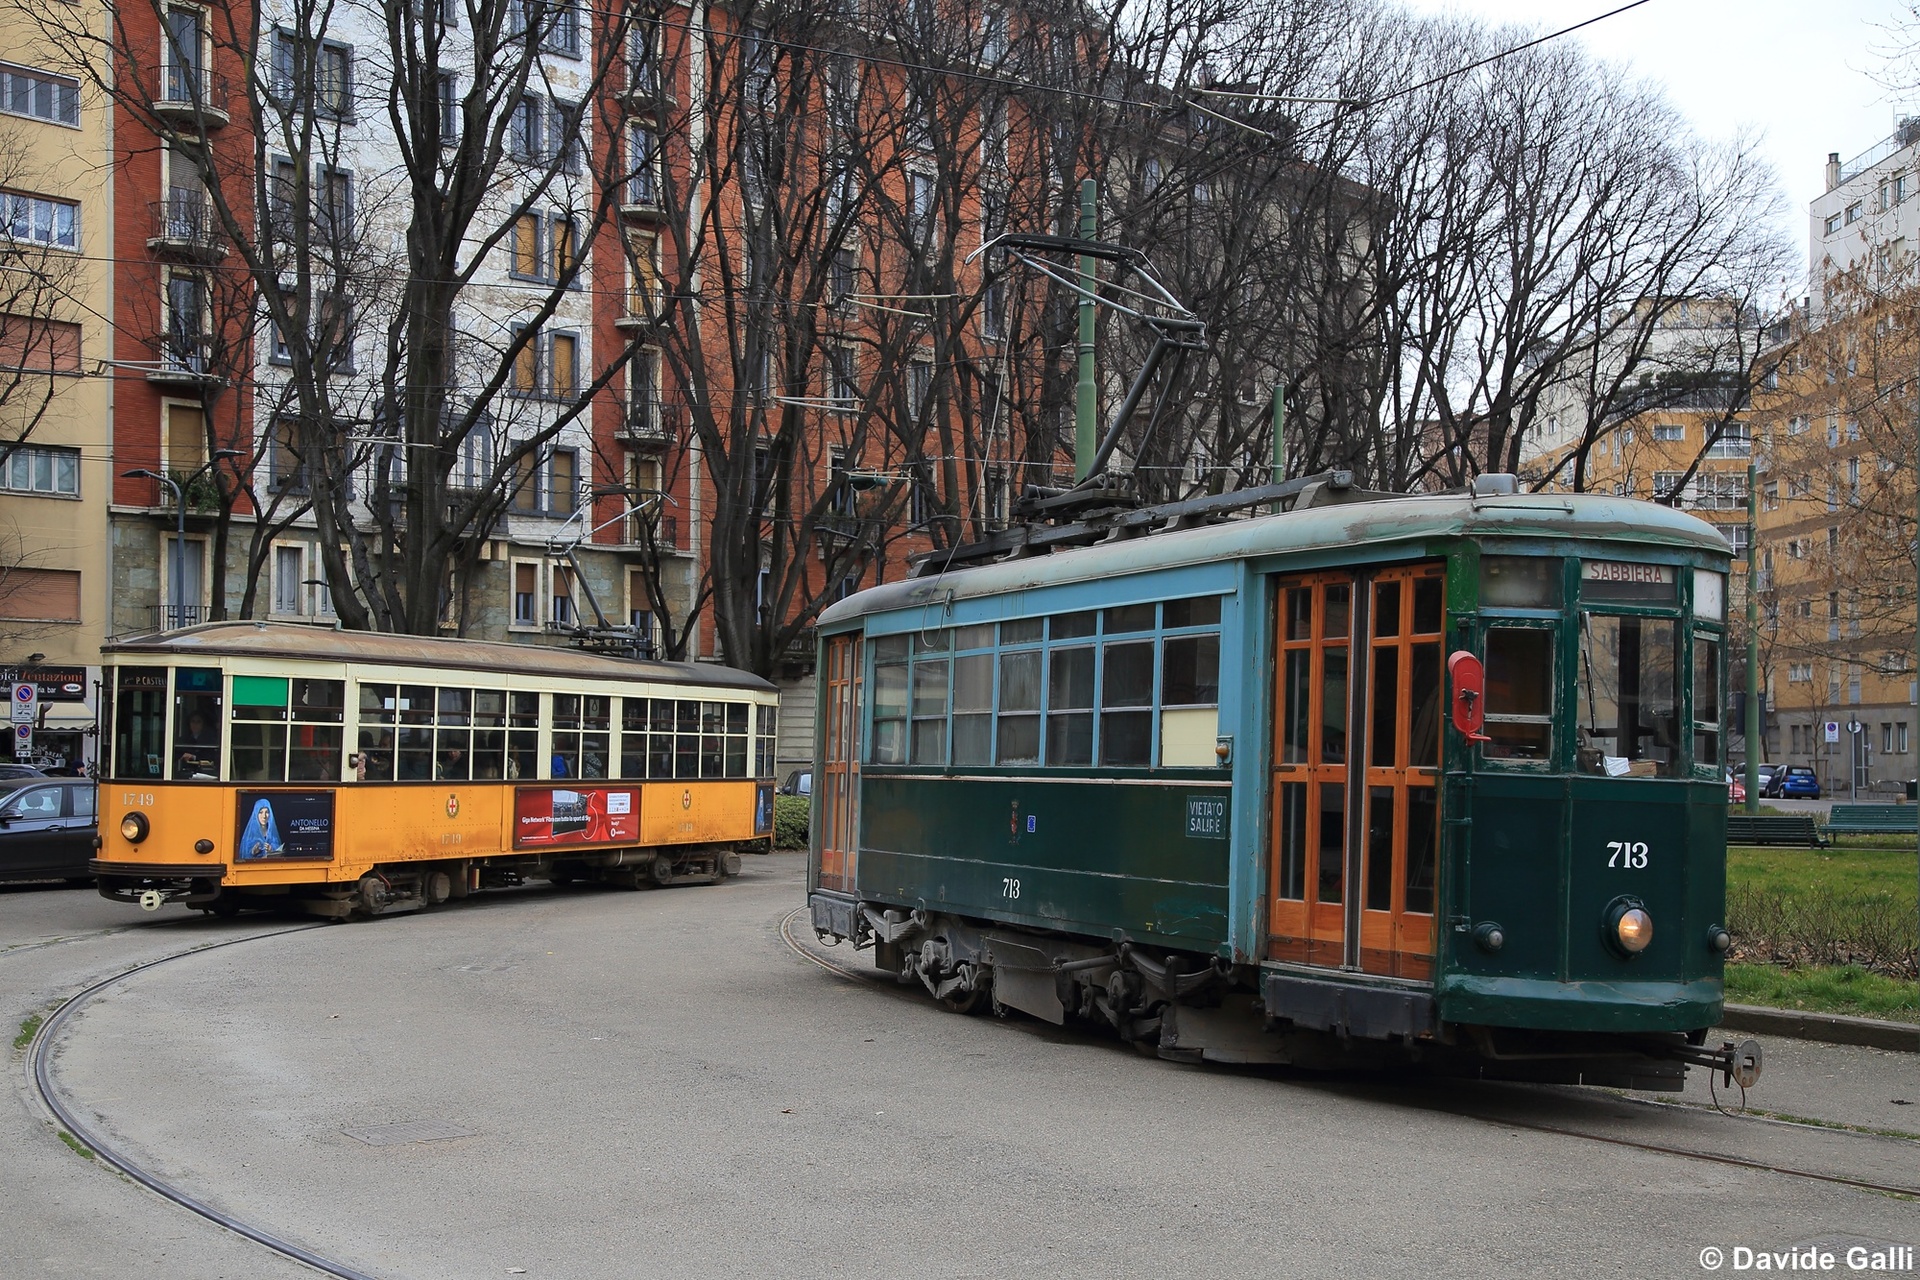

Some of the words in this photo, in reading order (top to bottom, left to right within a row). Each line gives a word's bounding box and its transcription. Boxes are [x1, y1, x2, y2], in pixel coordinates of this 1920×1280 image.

[1590, 562, 1663, 583] SABBIERA
[123, 793, 154, 806] 1749
[1189, 801, 1223, 816] VIETATO
[290, 819, 329, 827] ANTONELLO
[1190, 817, 1220, 833] SALIRE
[1606, 841, 1649, 869] 713
[1002, 877, 1021, 899] 713
